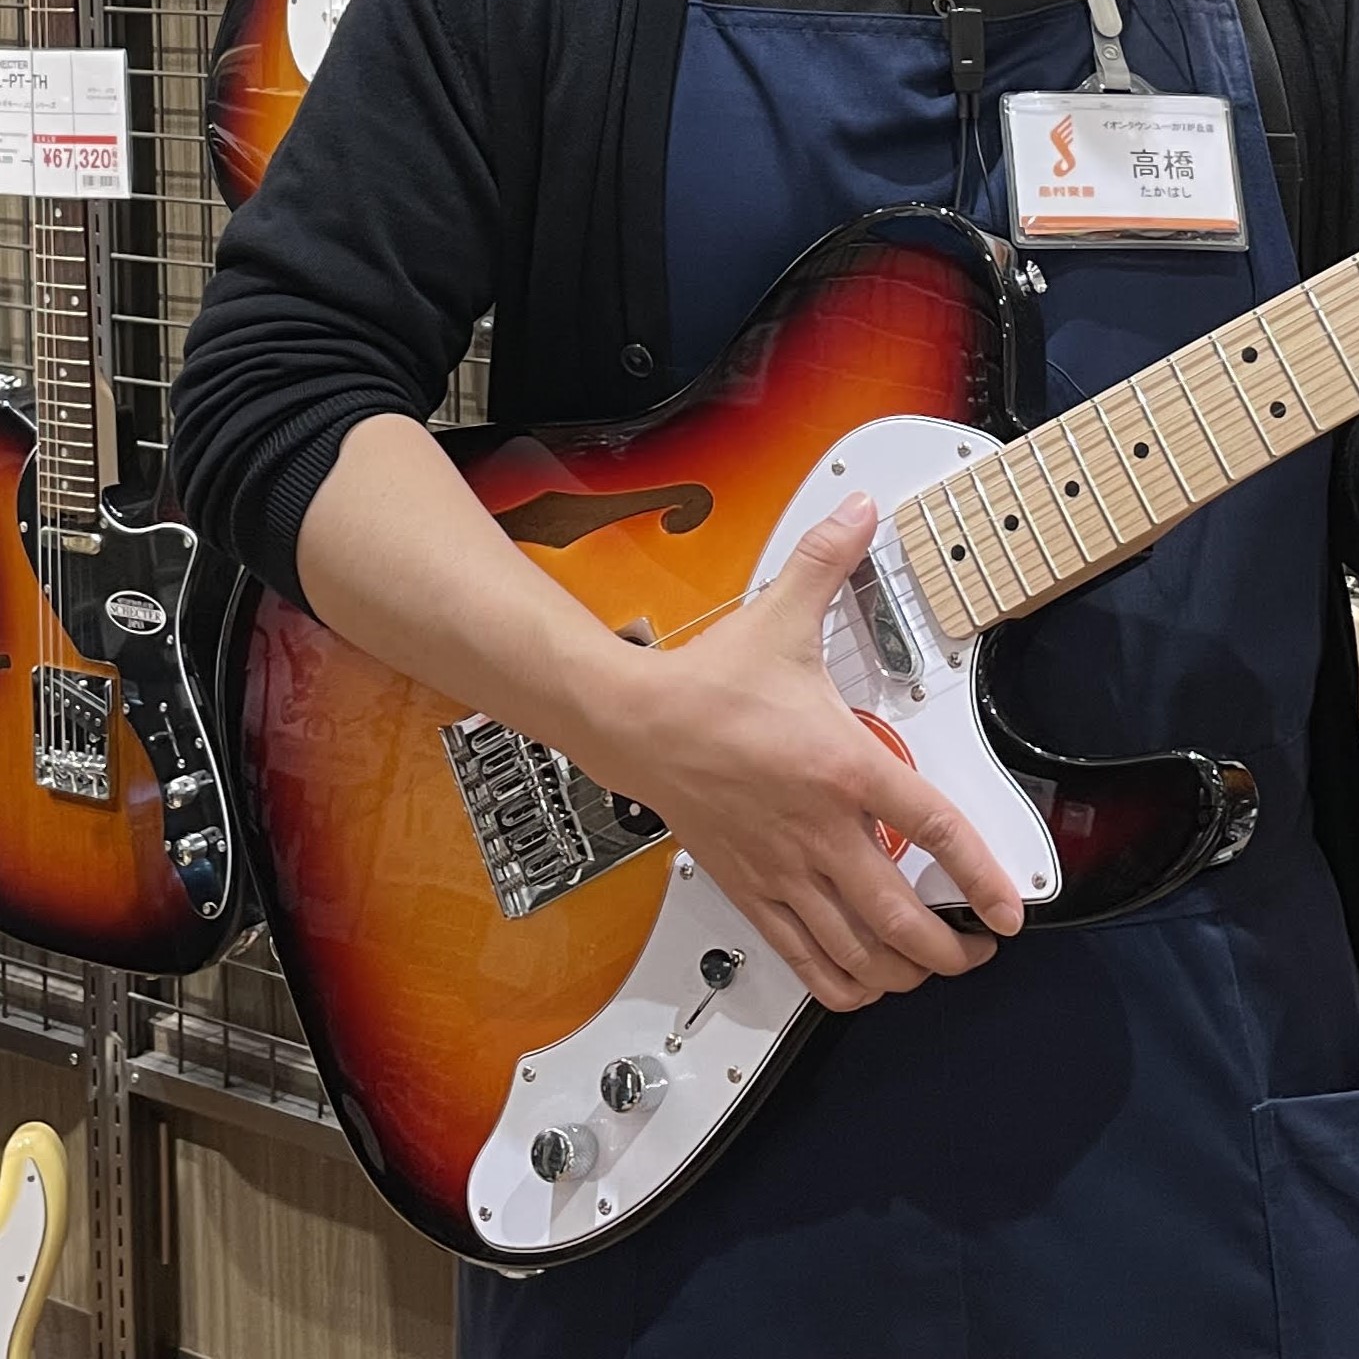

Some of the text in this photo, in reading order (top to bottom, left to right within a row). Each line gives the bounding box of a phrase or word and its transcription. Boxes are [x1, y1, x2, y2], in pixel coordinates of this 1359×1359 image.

[0, 73, 48, 90] -PT-TH
[42, 147, 112, 172] ¥67,320
[1129, 148, 1195, 181] 高橋
[1140, 185, 1193, 199] たかはし
